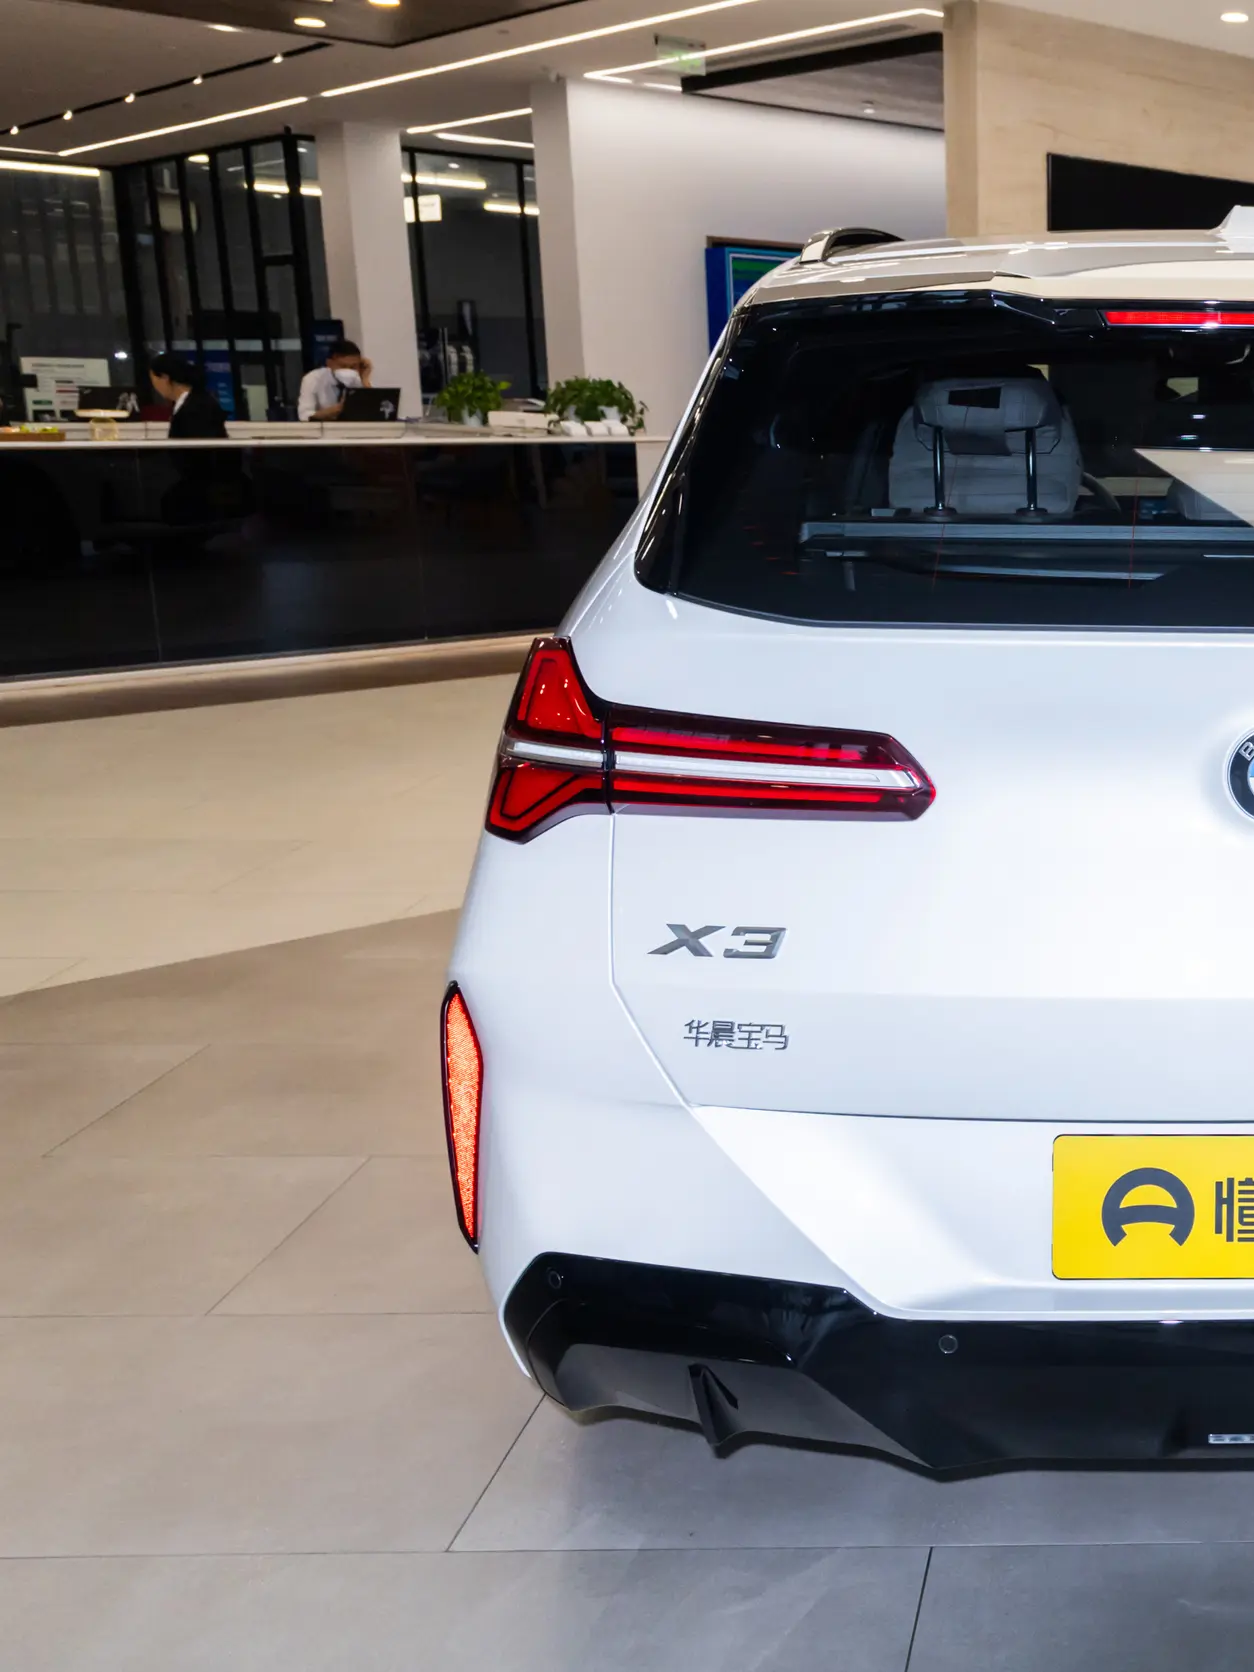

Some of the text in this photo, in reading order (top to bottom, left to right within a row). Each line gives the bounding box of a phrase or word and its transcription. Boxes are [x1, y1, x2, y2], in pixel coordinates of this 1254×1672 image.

[647, 923, 787, 960] X3
[683, 1019, 790, 1051] 华晨宝马
